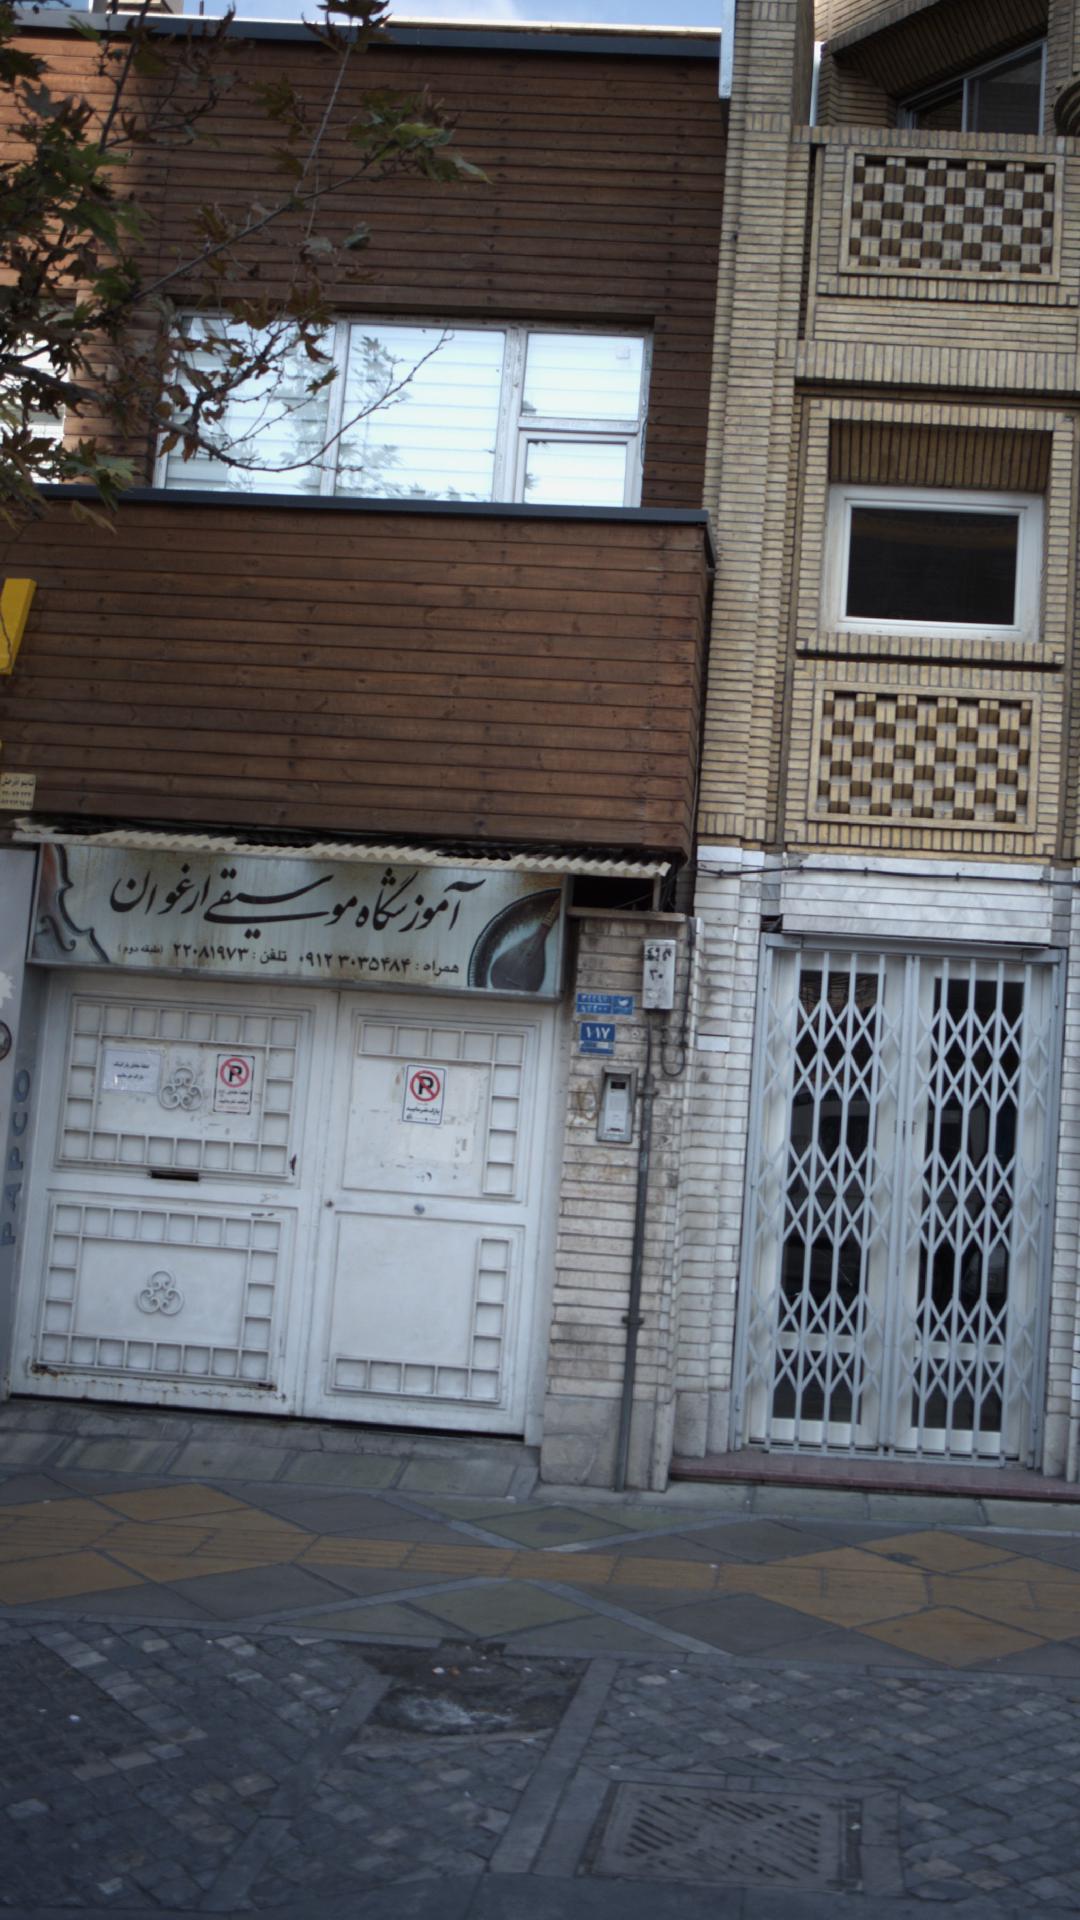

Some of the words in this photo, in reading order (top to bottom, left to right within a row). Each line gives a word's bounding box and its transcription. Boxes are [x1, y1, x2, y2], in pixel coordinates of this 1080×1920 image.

[109, 863, 212, 915] ارغوان
[203, 868, 358, 940] موسیقی
[355, 867, 486, 933] آموزشگاه
[173, 943, 249, 962] ۲۲۰۸۱۹۷۳
[586, 1026, 611, 1040] ۱۱۷
